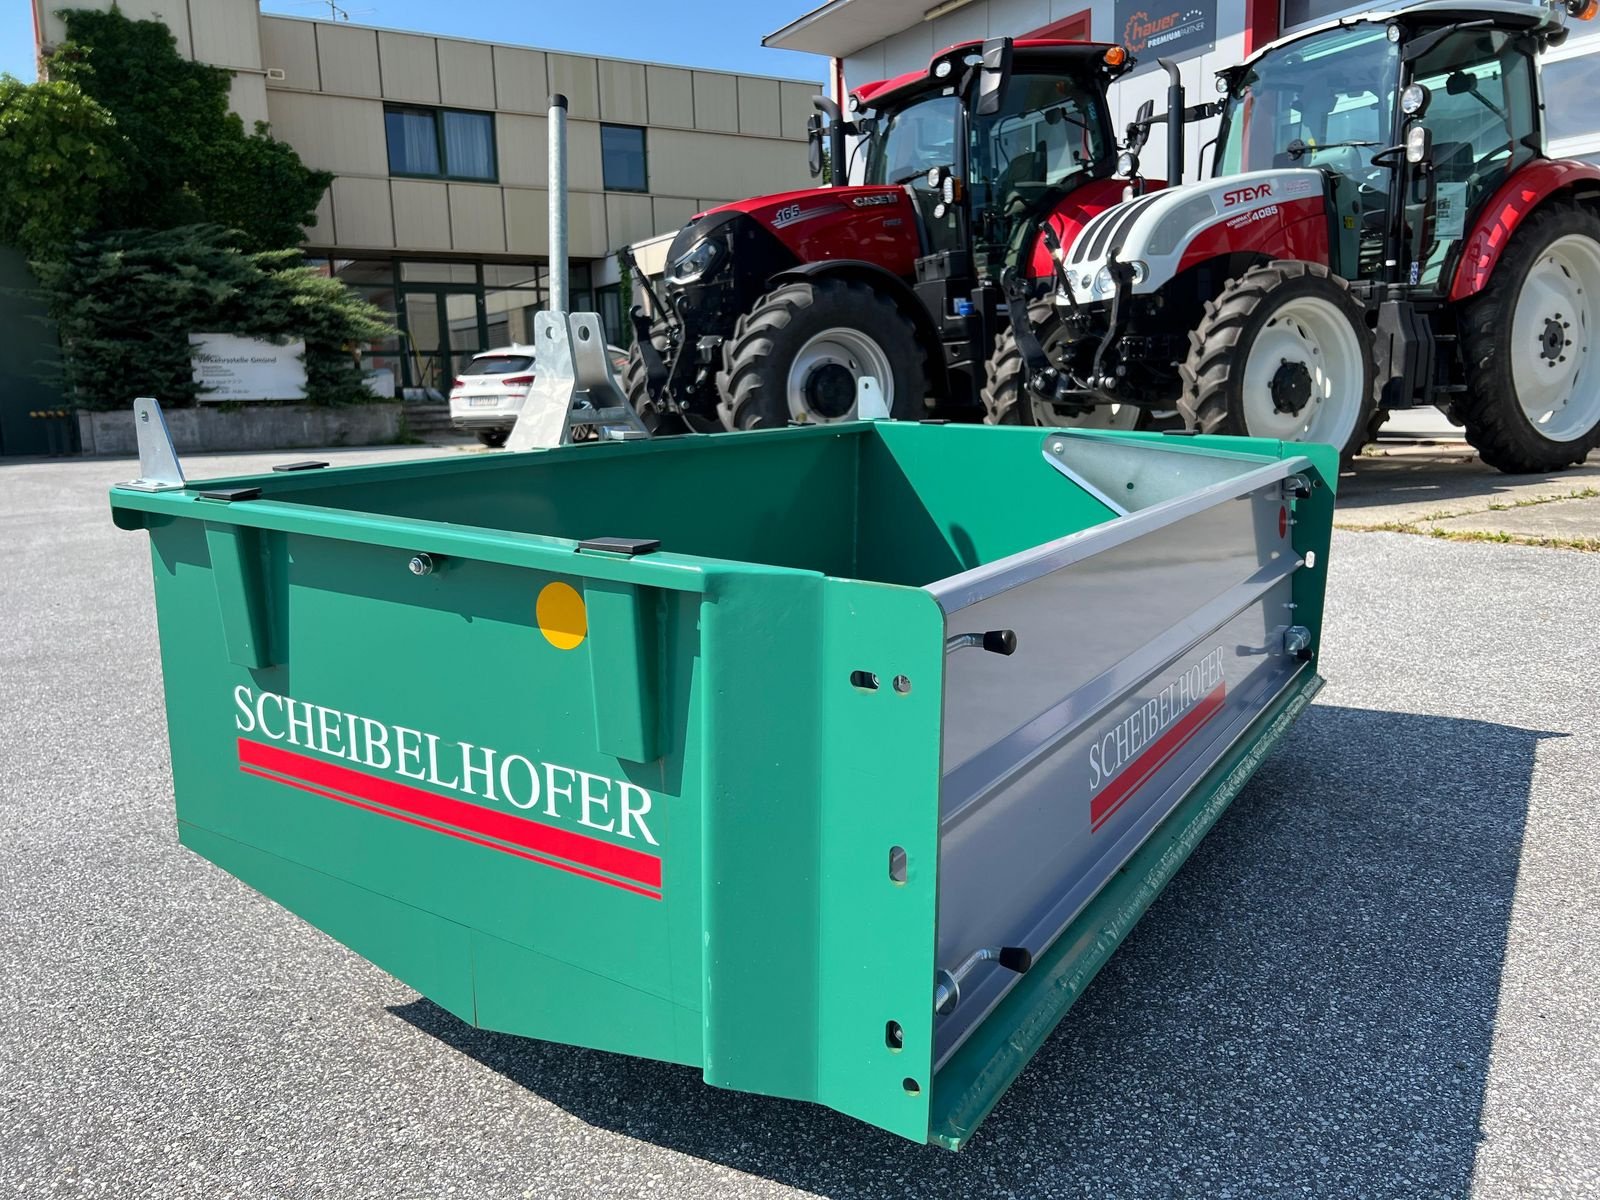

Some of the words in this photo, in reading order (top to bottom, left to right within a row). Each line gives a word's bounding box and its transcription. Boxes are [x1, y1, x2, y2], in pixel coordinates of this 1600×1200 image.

[1132, 12, 1180, 41] hauer
[1223, 183, 1273, 207] STEYR
[775, 204, 801, 222] 165
[1251, 205, 1279, 221] 4085
[1089, 645, 1225, 791] SCHEIBELHOFER
[233, 685, 660, 846] SCHEIBELHOFER
